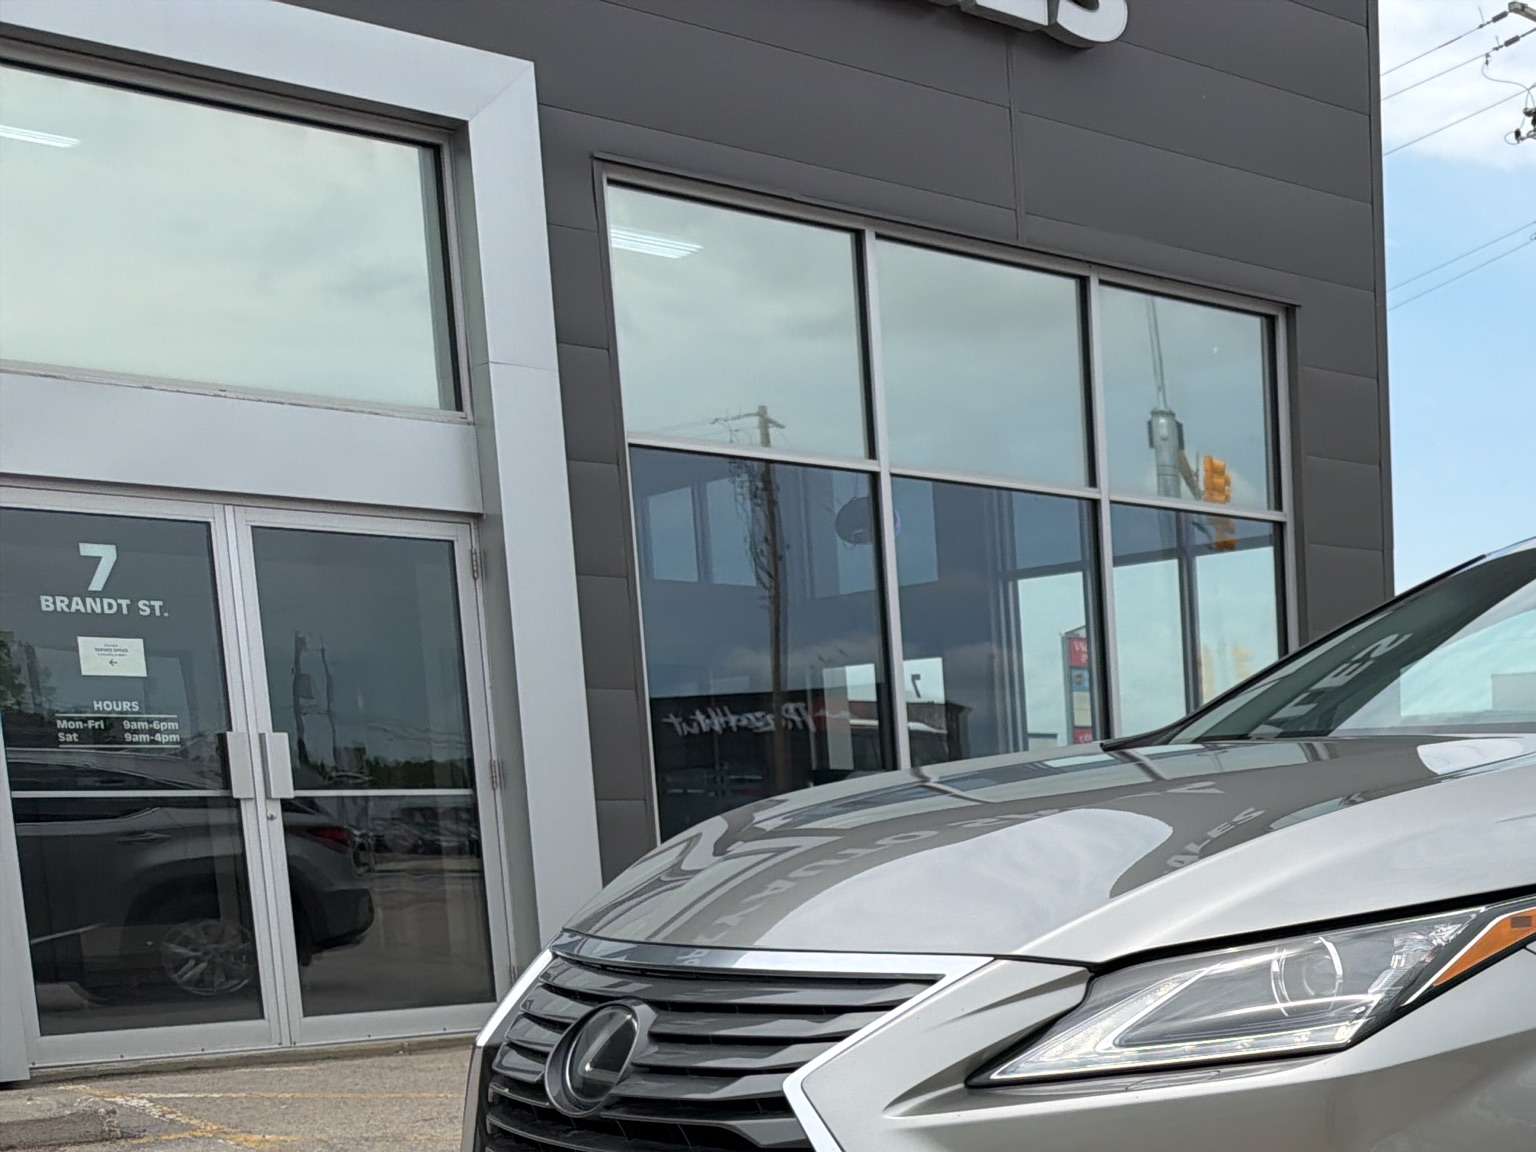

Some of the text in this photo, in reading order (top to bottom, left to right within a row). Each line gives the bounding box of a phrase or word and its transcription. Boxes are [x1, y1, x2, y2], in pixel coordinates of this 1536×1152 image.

[78, 542, 118, 592] 7
[40, 595, 169, 617] BRANDT ST.
[93, 700, 140, 712] HOURS
[56, 719, 179, 731] Mon-Fri 9am-6pm
[57, 732, 181, 743] Sat 9am-4pm
